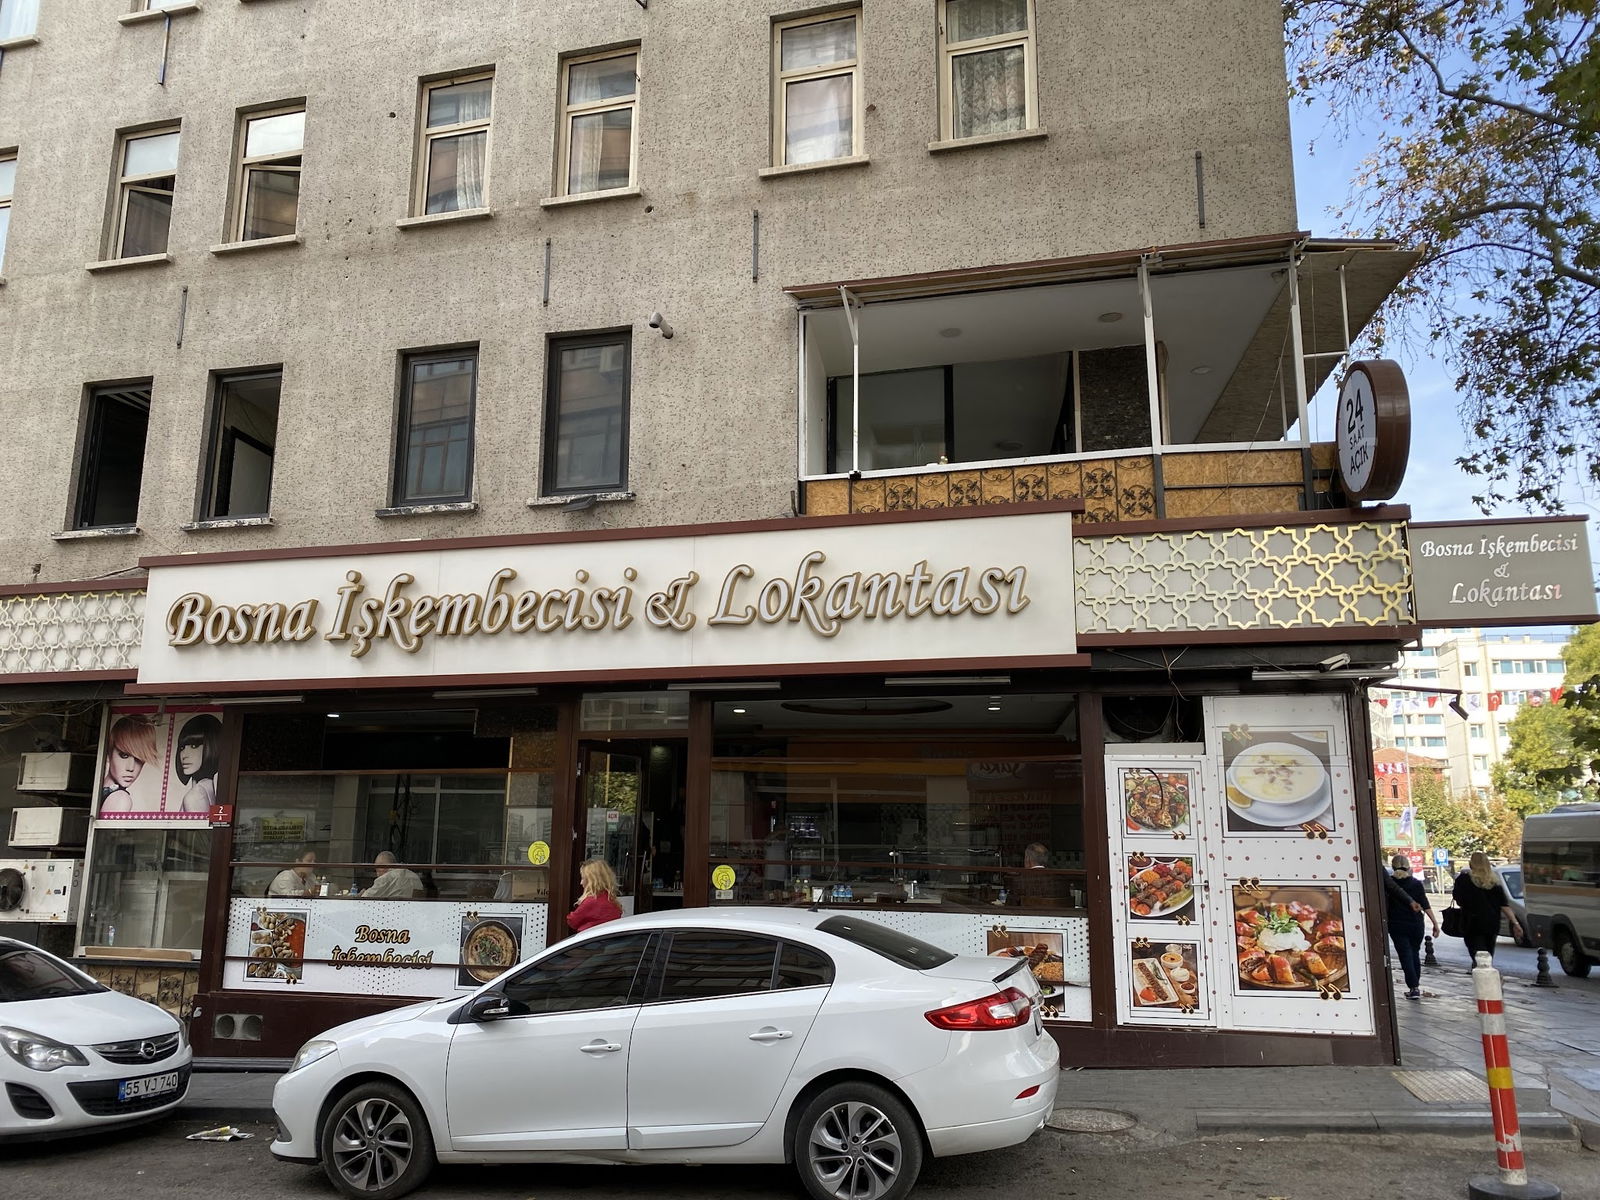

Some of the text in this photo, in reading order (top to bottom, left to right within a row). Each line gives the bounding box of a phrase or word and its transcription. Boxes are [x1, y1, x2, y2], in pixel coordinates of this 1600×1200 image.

[1346, 388, 1364, 434] 24
[1349, 424, 1365, 450] SAAT
[1350, 441, 1369, 475] AÇIK
[1421, 540, 1474, 557] Bosna
[1493, 562, 1510, 578] &
[166, 550, 1031, 658] Bosna İşkembecisi & Lokantası
[1449, 578, 1562, 608] Lokantası
[355, 925, 410, 943] Bosna
[126, 1081, 139, 1095] 55
[144, 1078, 157, 1092] VJ
[160, 1074, 178, 1089] 740
